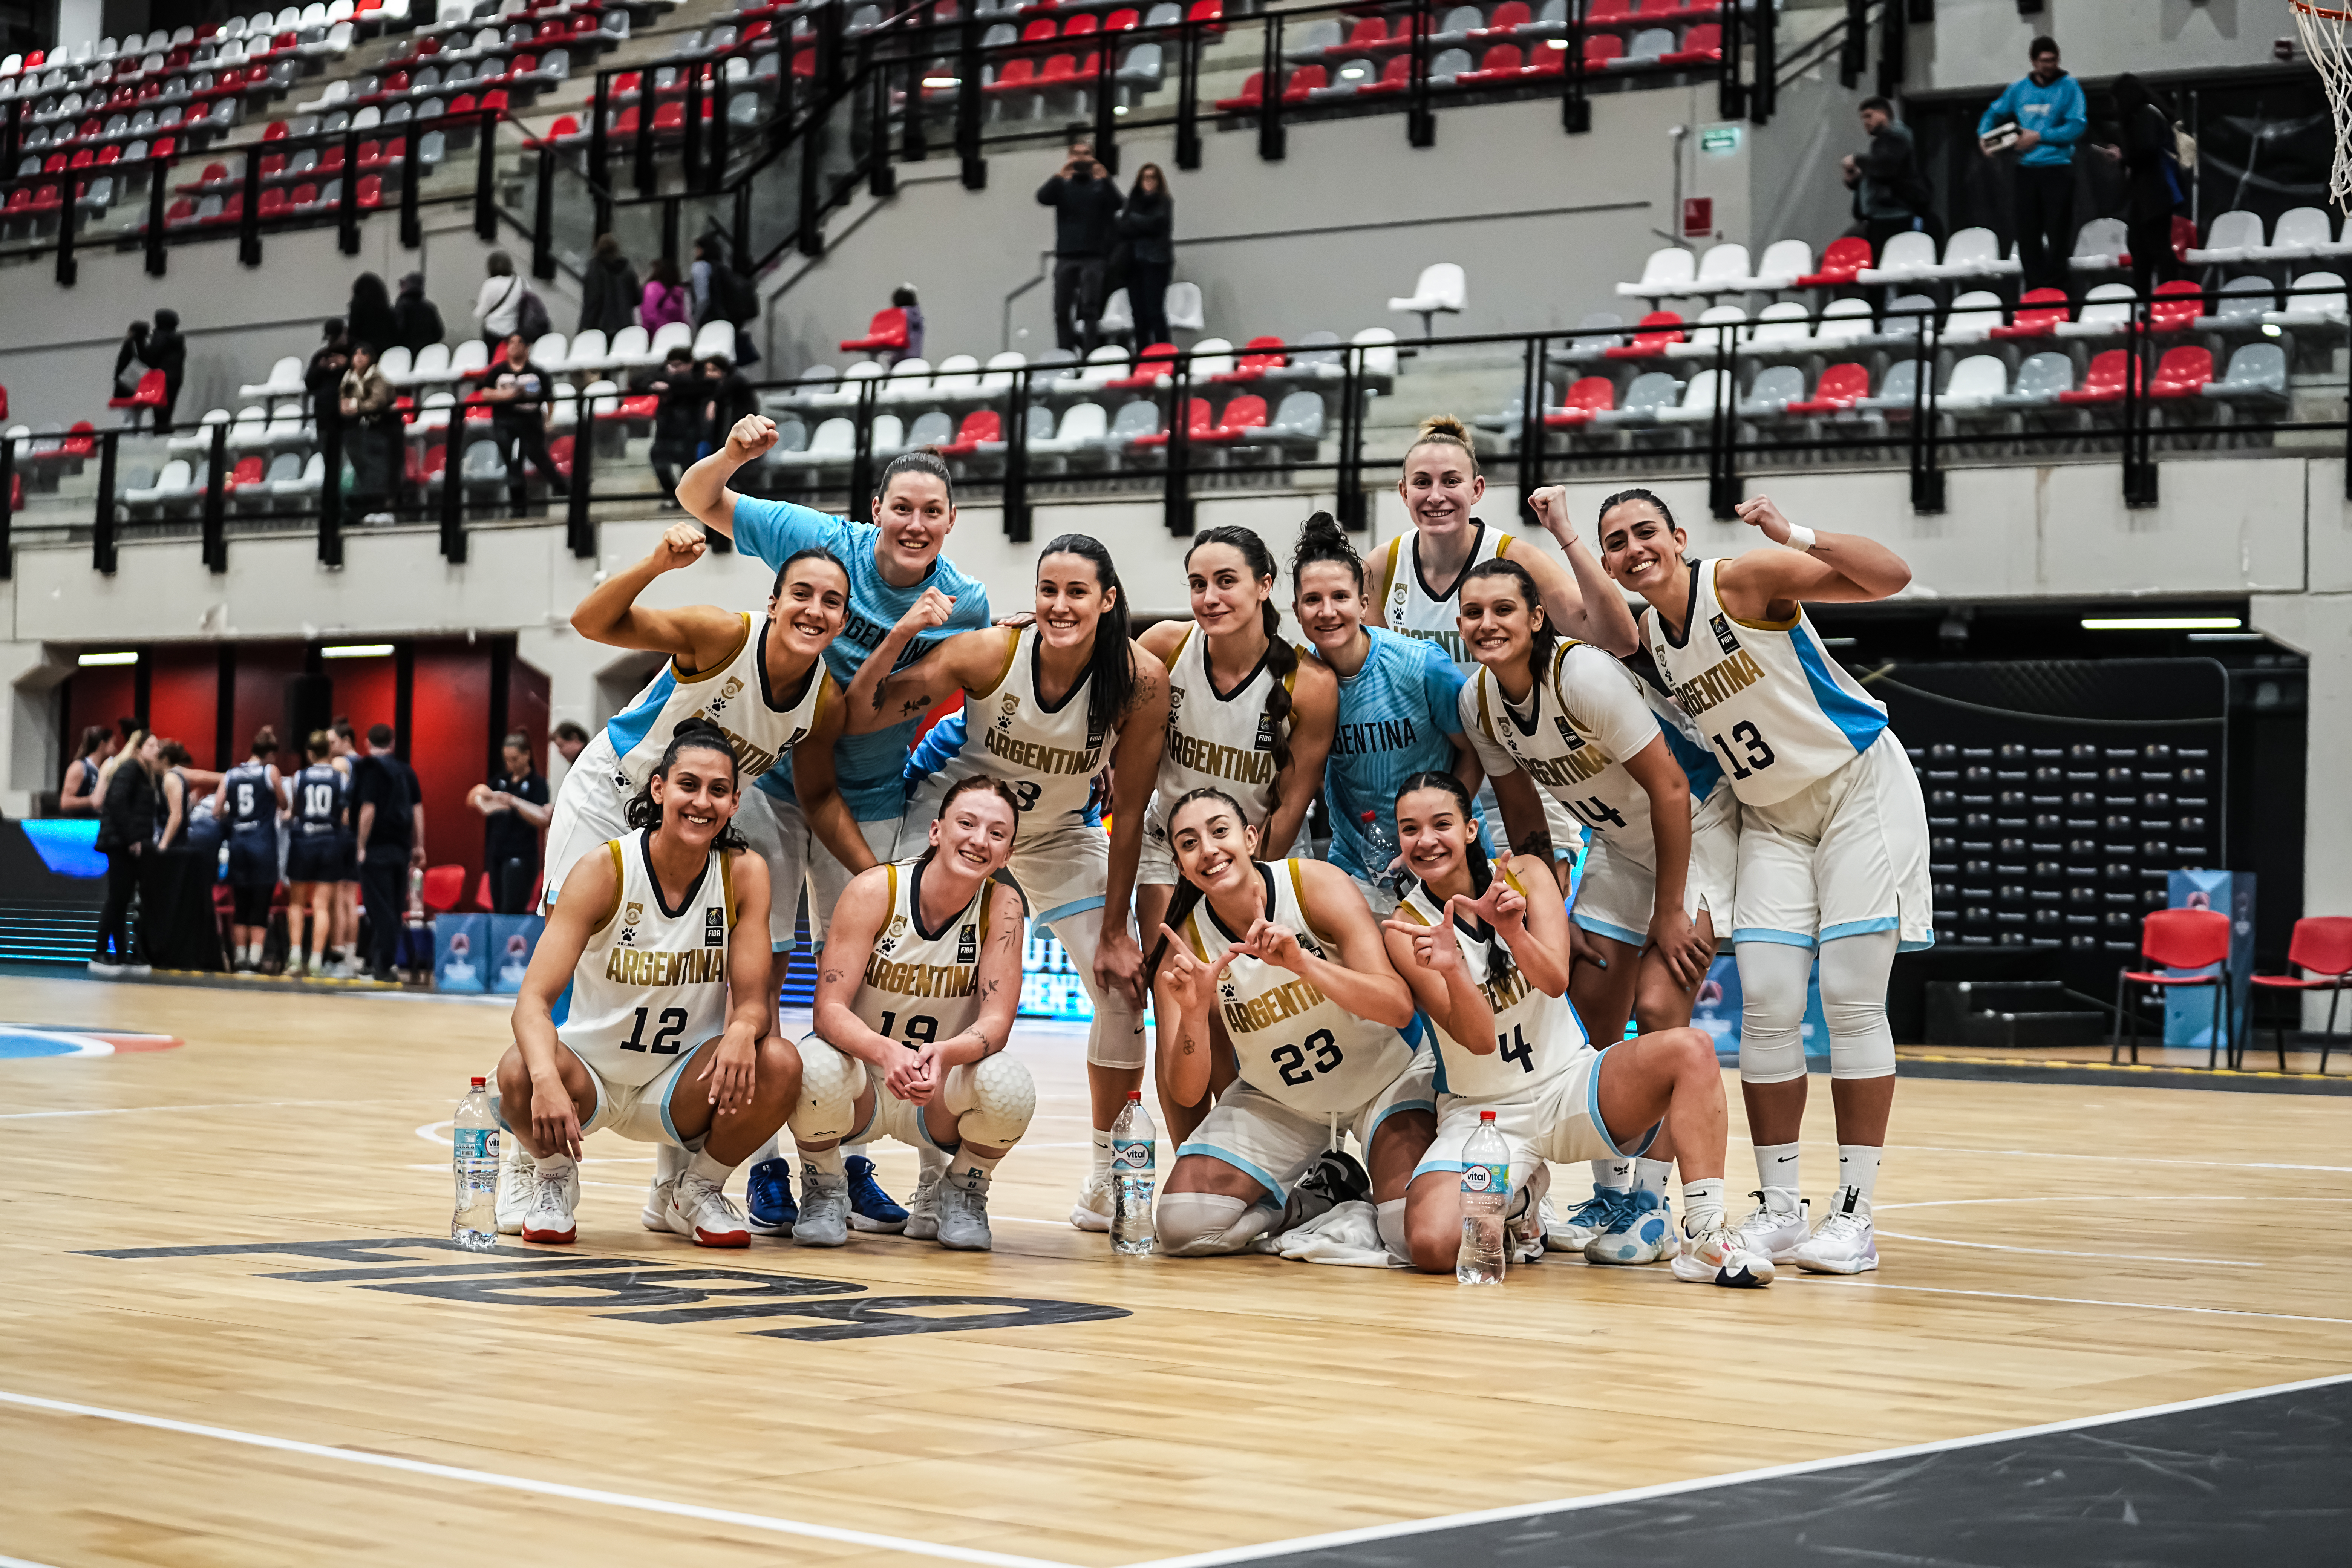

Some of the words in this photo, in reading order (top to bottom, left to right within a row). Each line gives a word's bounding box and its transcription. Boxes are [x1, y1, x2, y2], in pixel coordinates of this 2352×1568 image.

[1721, 634, 1733, 645] FIBA
[705, 706, 720, 718] KELME
[985, 726, 1101, 775] ARGENTINA
[1330, 718, 1417, 754] GENTINA
[1712, 720, 1775, 781] 13
[237, 783, 254, 816] 5
[304, 784, 333, 817] 10
[1560, 796, 1627, 831] 14
[1149, 831, 1164, 842] KELME
[606, 947, 724, 986] ARGENTINA
[864, 952, 978, 998] ARGENTINA
[1224, 979, 1326, 1034] ARGENTI
[620, 1007, 689, 1054] 12
[880, 1010, 939, 1052] 19
[1498, 1023, 1534, 1073] 4
[1270, 1028, 1344, 1087] 23
[489, 1138, 499, 1146] vita
[1127, 1149, 1145, 1158] vital
[1467, 1171, 1486, 1181] vital
[64, 1237, 1133, 1342] FIBA
